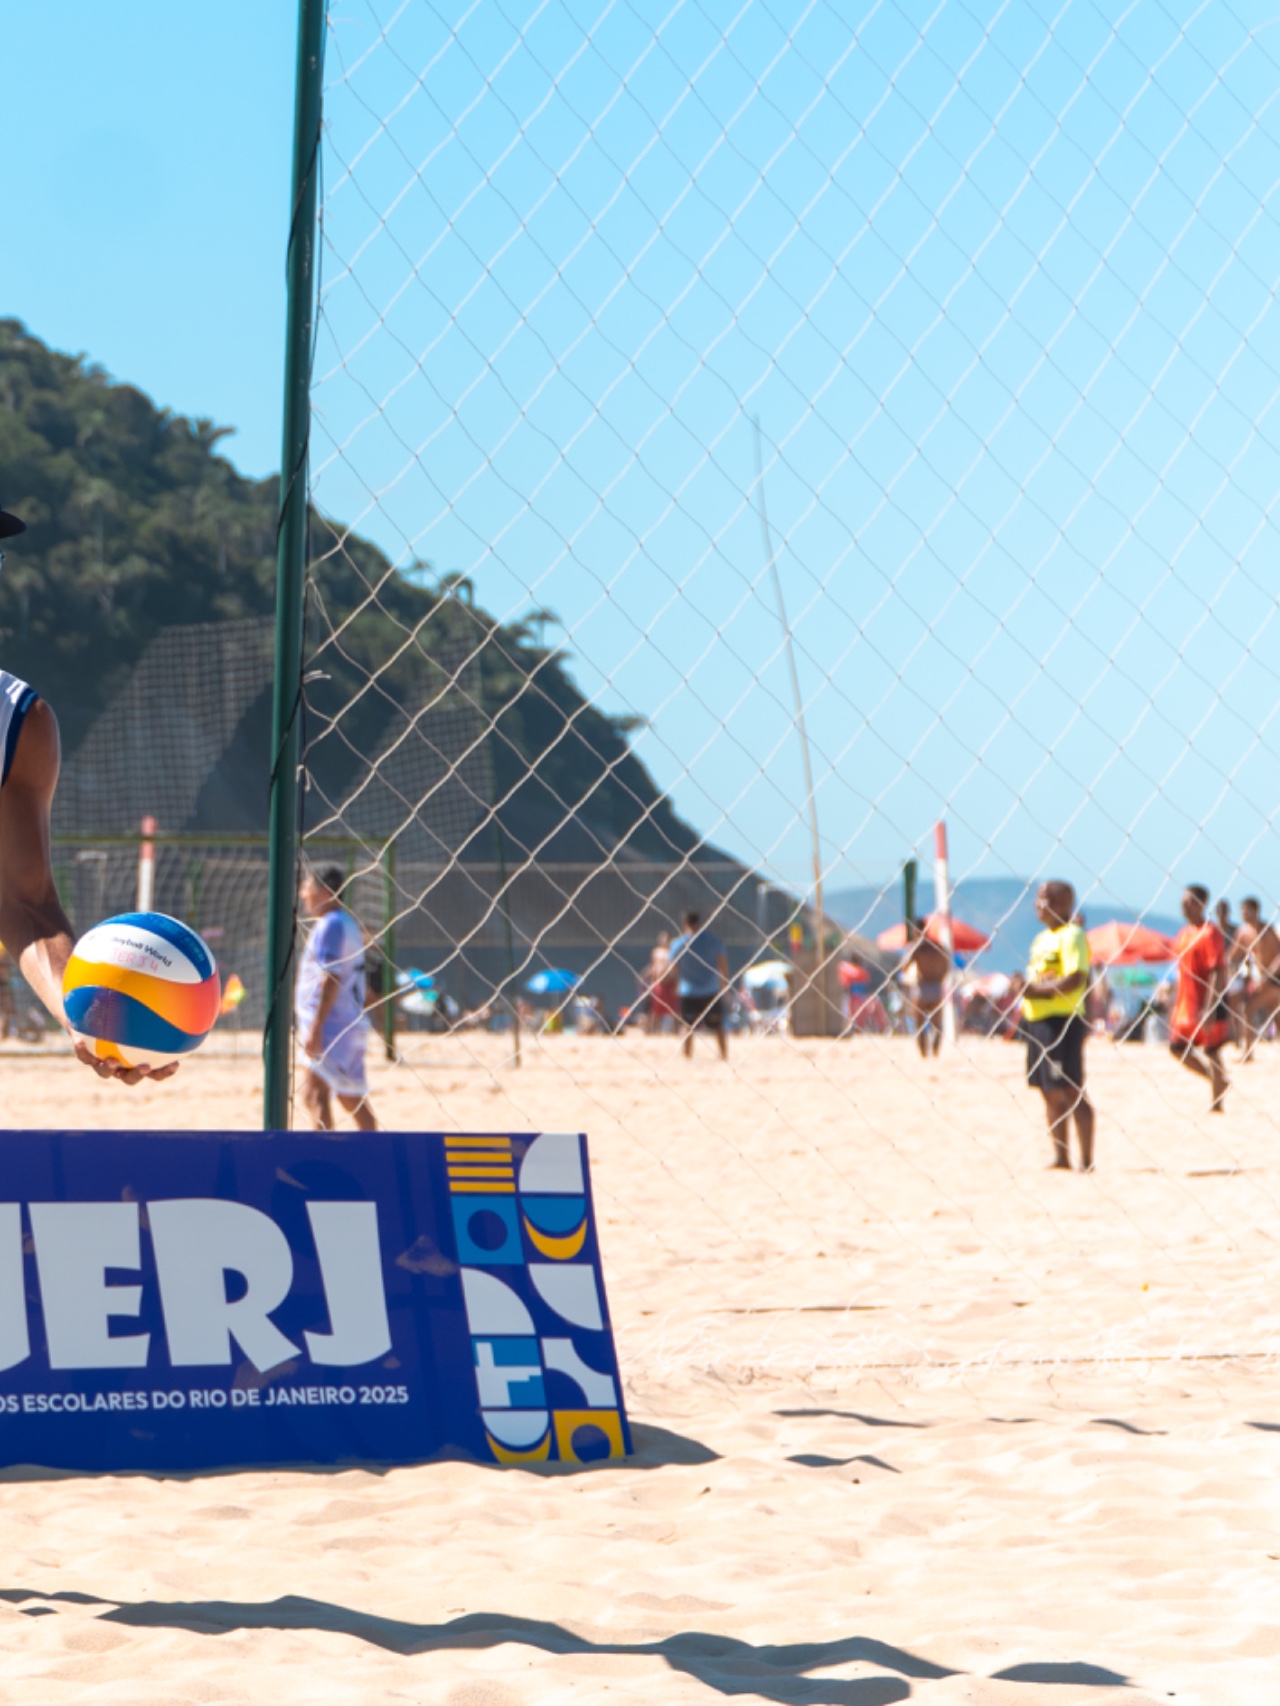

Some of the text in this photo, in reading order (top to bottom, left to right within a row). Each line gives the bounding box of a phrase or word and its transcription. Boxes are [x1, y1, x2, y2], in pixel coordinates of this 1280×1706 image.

[23, 1391, 148, 1413] ESCOLARES
[152, 1390, 185, 1409] DO
[189, 1389, 227, 1408] RIO
[231, 1388, 261, 1407] DE
[265, 1386, 356, 1406] JANEIRO
[359, 1385, 410, 1405] 2025
